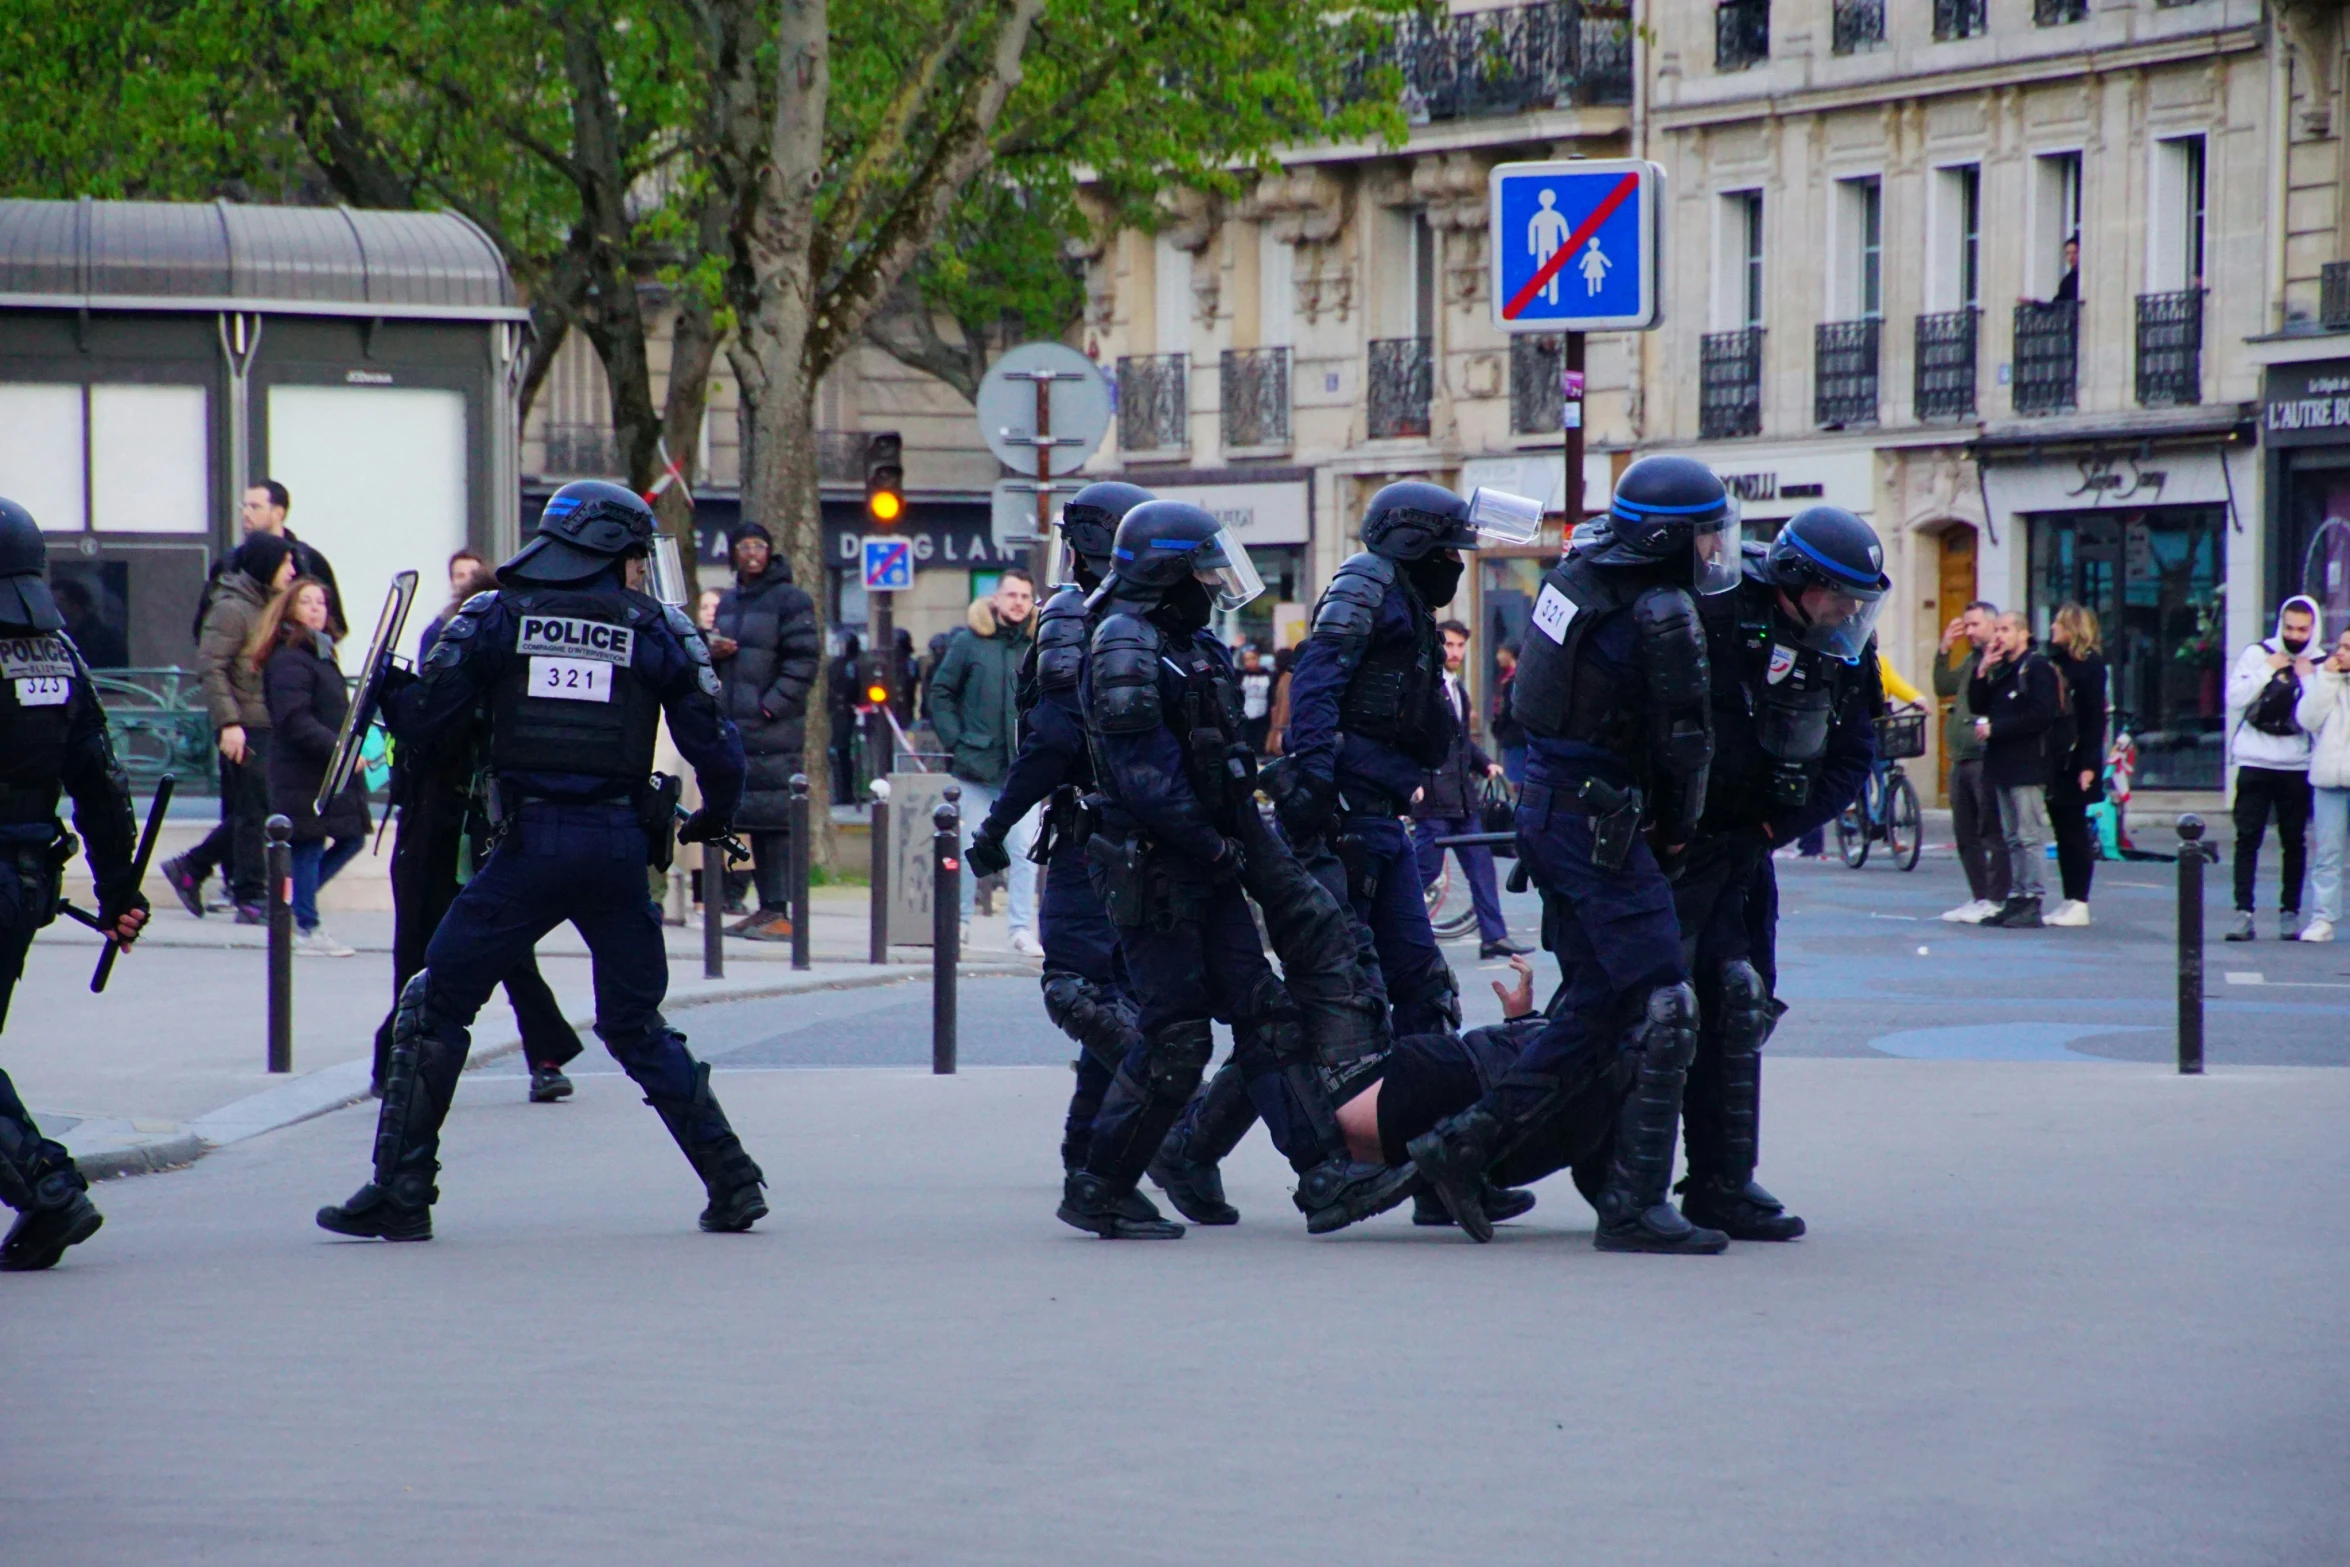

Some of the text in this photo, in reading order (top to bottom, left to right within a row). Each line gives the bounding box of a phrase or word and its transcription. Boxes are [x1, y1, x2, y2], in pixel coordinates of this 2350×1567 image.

[2268, 398, 2333, 429] L'AUTRE
[524, 620, 628, 653] POLICE
[0, 639, 70, 664] POLICE
[522, 643, 625, 662] COMPAGNIE D'INTERVENTION
[548, 668, 593, 690] 321
